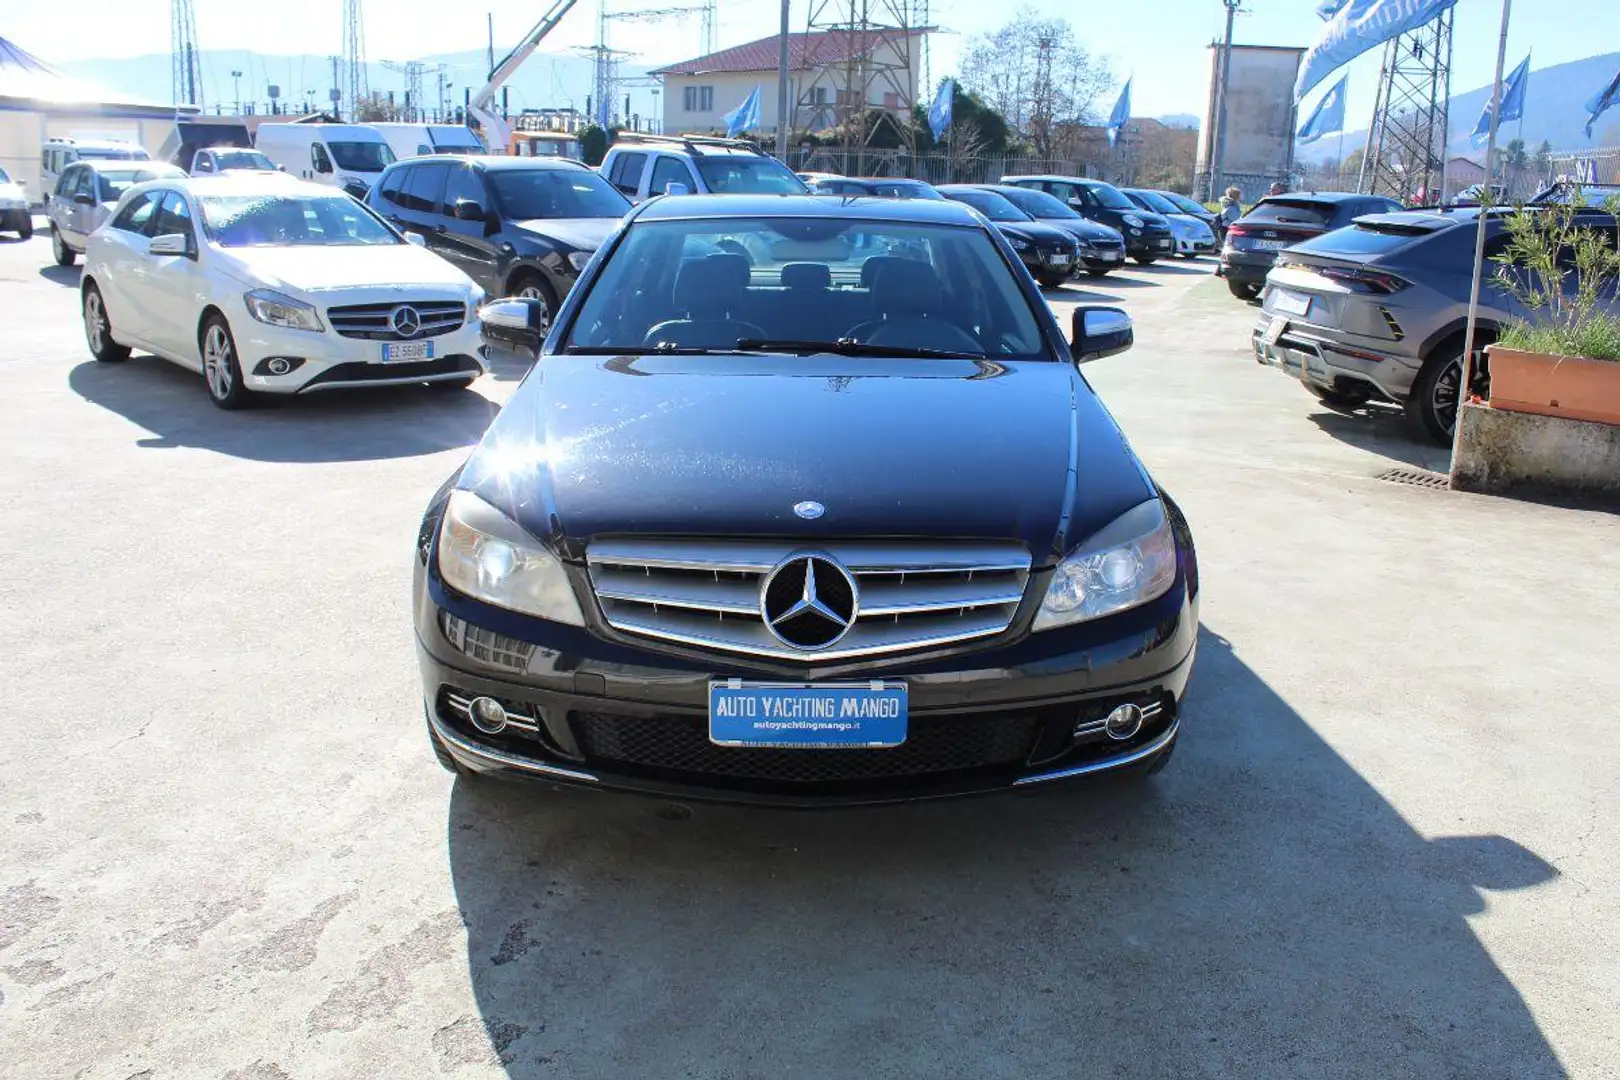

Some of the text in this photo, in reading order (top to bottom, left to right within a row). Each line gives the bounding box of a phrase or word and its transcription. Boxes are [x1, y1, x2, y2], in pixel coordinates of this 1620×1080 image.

[716, 696, 899, 718] AUTO YACHTING MANGO
[753, 721, 860, 732] autoyachtingmango.it
